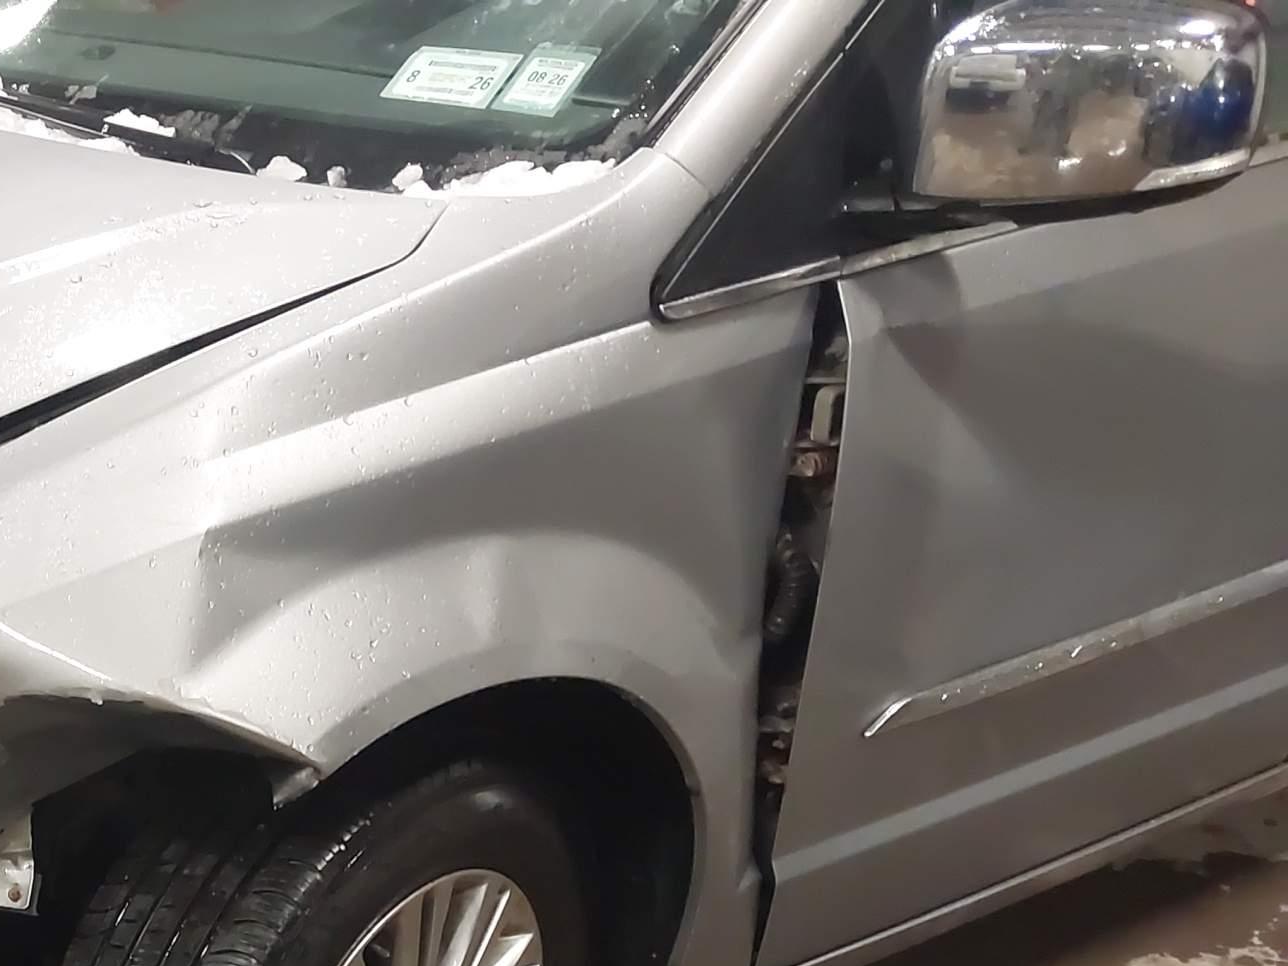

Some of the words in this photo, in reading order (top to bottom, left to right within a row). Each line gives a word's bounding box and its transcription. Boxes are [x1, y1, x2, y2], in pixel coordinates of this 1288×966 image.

[406, 70, 421, 83] 8
[468, 76, 494, 90] 26
[527, 70, 547, 83] 08
[548, 73, 568, 86] 26
